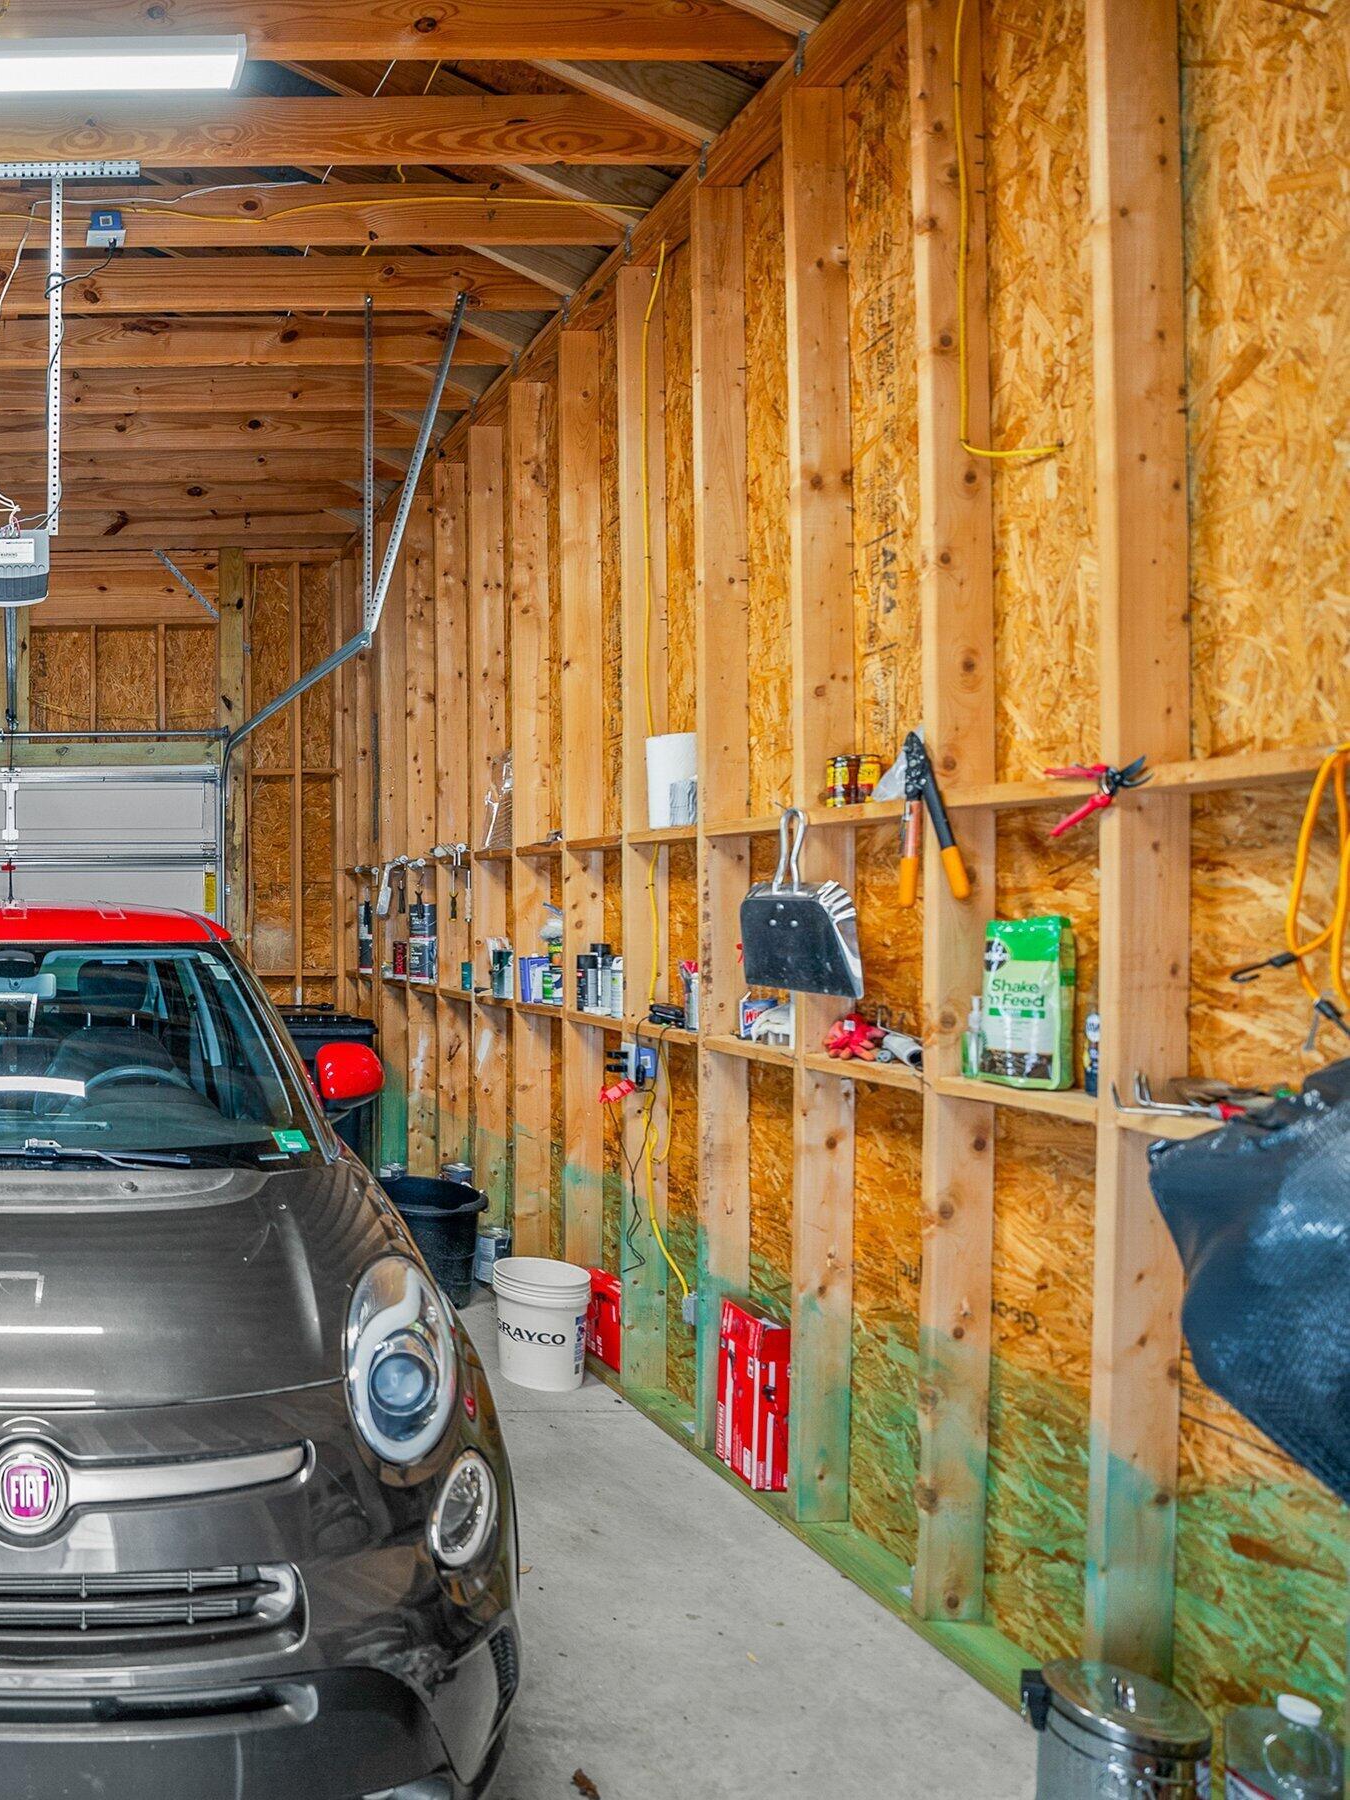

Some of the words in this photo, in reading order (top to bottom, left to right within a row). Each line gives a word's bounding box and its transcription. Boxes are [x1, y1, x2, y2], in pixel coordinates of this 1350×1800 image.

[881, 547, 897, 614] APA
[992, 979, 1039, 993] Shake
[1003, 993, 1044, 1007] Feed
[716, 1405, 725, 1455] CRAFTSMAN
[10, 1474, 48, 1508] FIAT
